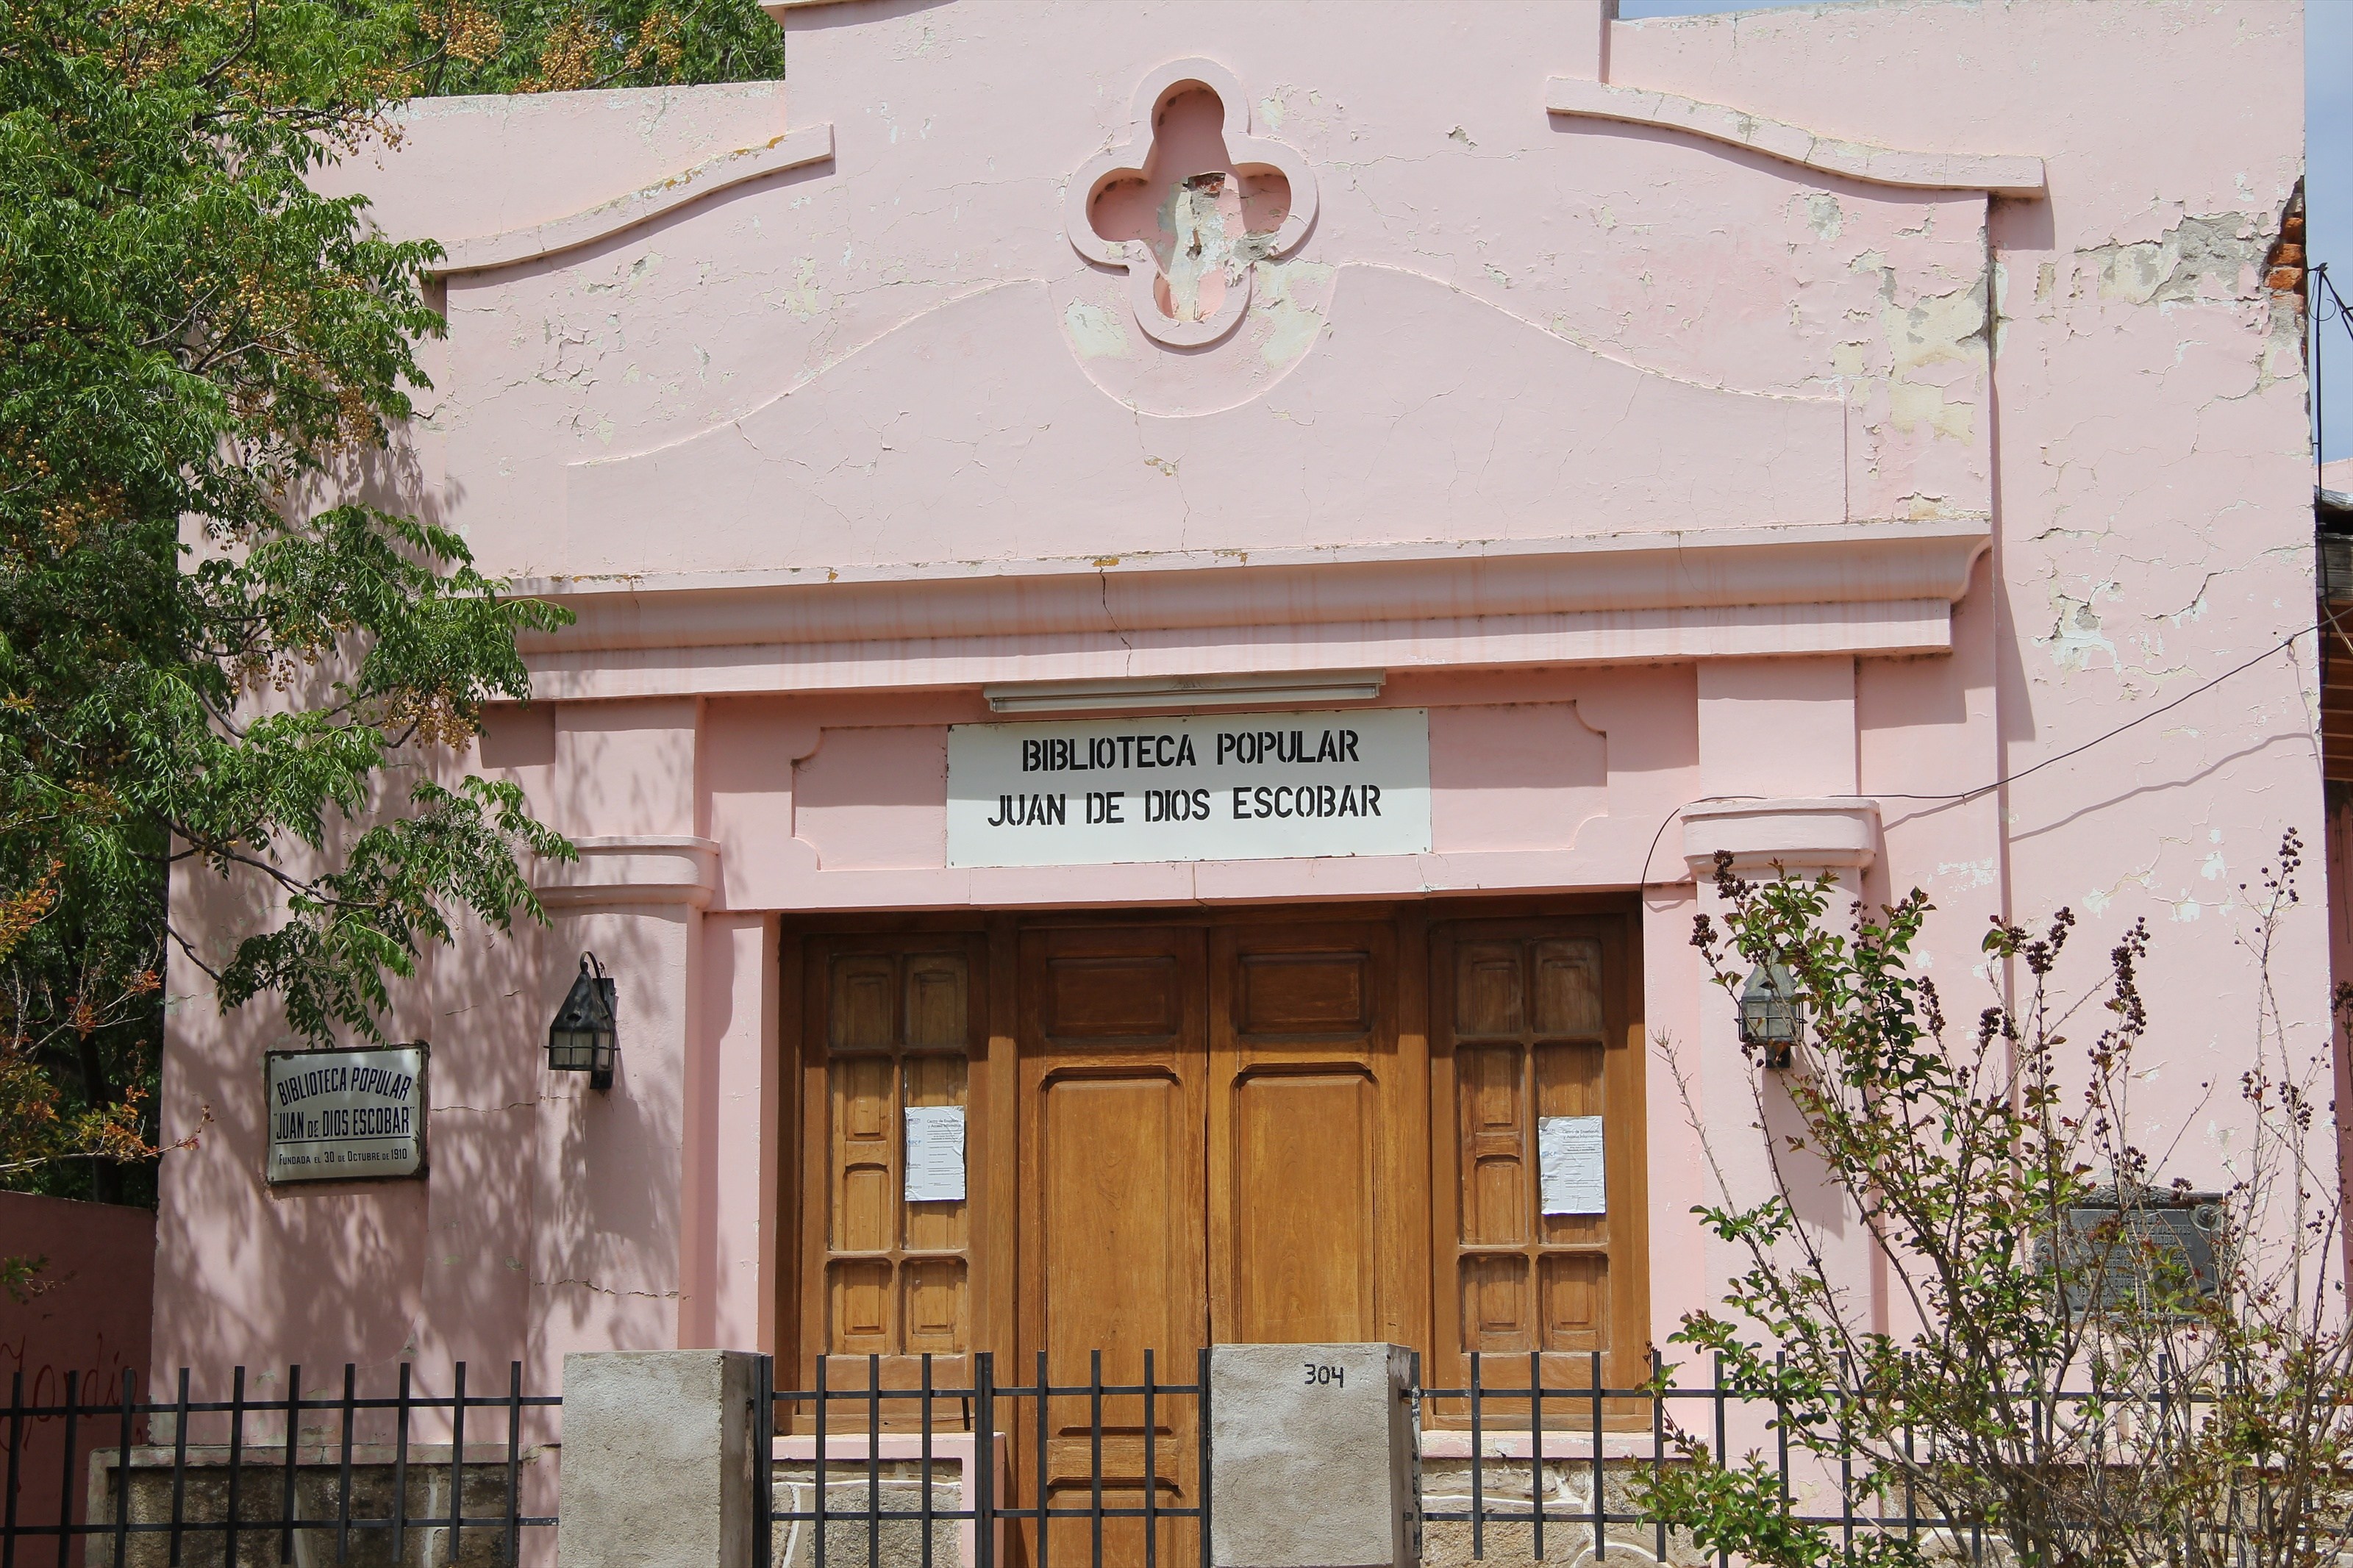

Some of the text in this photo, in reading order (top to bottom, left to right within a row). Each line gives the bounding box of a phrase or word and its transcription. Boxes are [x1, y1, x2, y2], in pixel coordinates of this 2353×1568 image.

[1022, 729, 1360, 772] BIBLIOTECA POPULAR
[988, 784, 1382, 826] JUAN DE DIOS ESCOBAR
[276, 1067, 413, 1106] BIBLIOTECA POPULAR
[307, 1120, 319, 1138] DE
[322, 1109, 349, 1137] DIOS
[324, 1151, 335, 1163] 30
[347, 1150, 380, 1161] OCTUBRE
[382, 1153, 390, 1161] DE
[390, 1148, 407, 1160] 1910
[1304, 1364, 1344, 1389] 304
